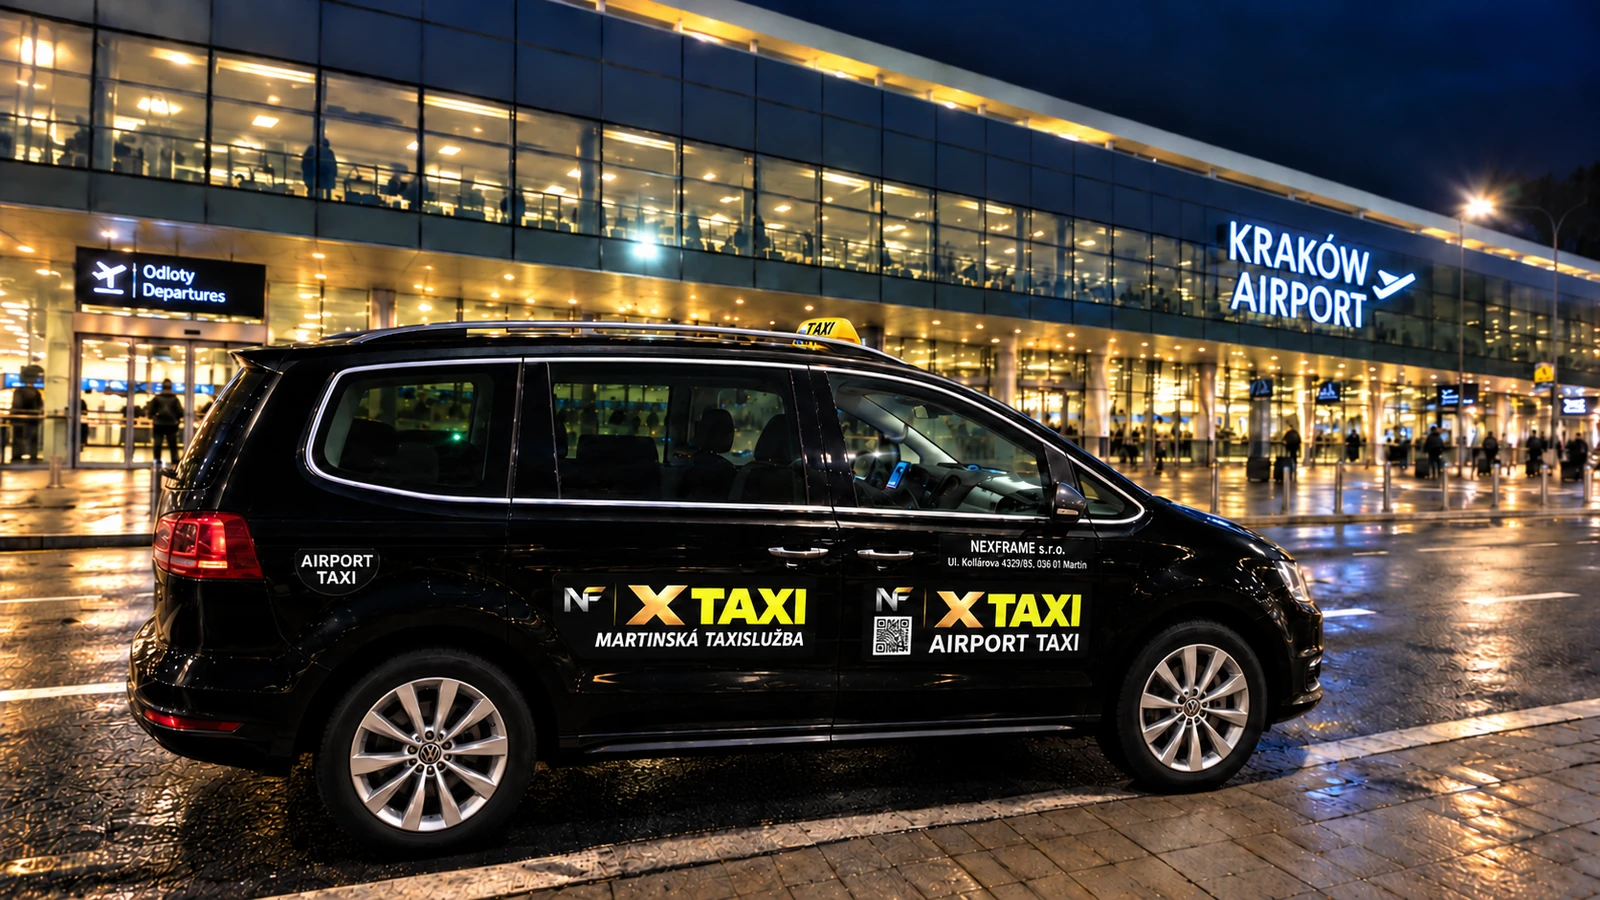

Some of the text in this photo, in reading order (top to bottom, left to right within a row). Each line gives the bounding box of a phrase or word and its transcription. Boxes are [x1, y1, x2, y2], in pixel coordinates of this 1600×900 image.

[1229, 220, 1370, 286] KRAKÓW
[142, 264, 196, 286] Odloty
[142, 281, 226, 303] Departures
[1230, 271, 1368, 328] AIRPORT
[806, 321, 836, 335] TAXI
[970, 539, 1066, 555] NEXFRAME s.r.o.
[300, 554, 374, 568] AIRPORT
[947, 557, 960, 567] Ul.
[961, 557, 1000, 568] Kollárova
[1052, 560, 1061, 569] 01
[1062, 560, 1088, 570] Martin
[316, 570, 357, 585] TAXI
[563, 586, 606, 612] NF
[875, 586, 915, 612] NF
[595, 628, 805, 648] MARTINSKÁ TAXISLUŽBA
[928, 633, 1080, 653] AIRPORT TAXI
